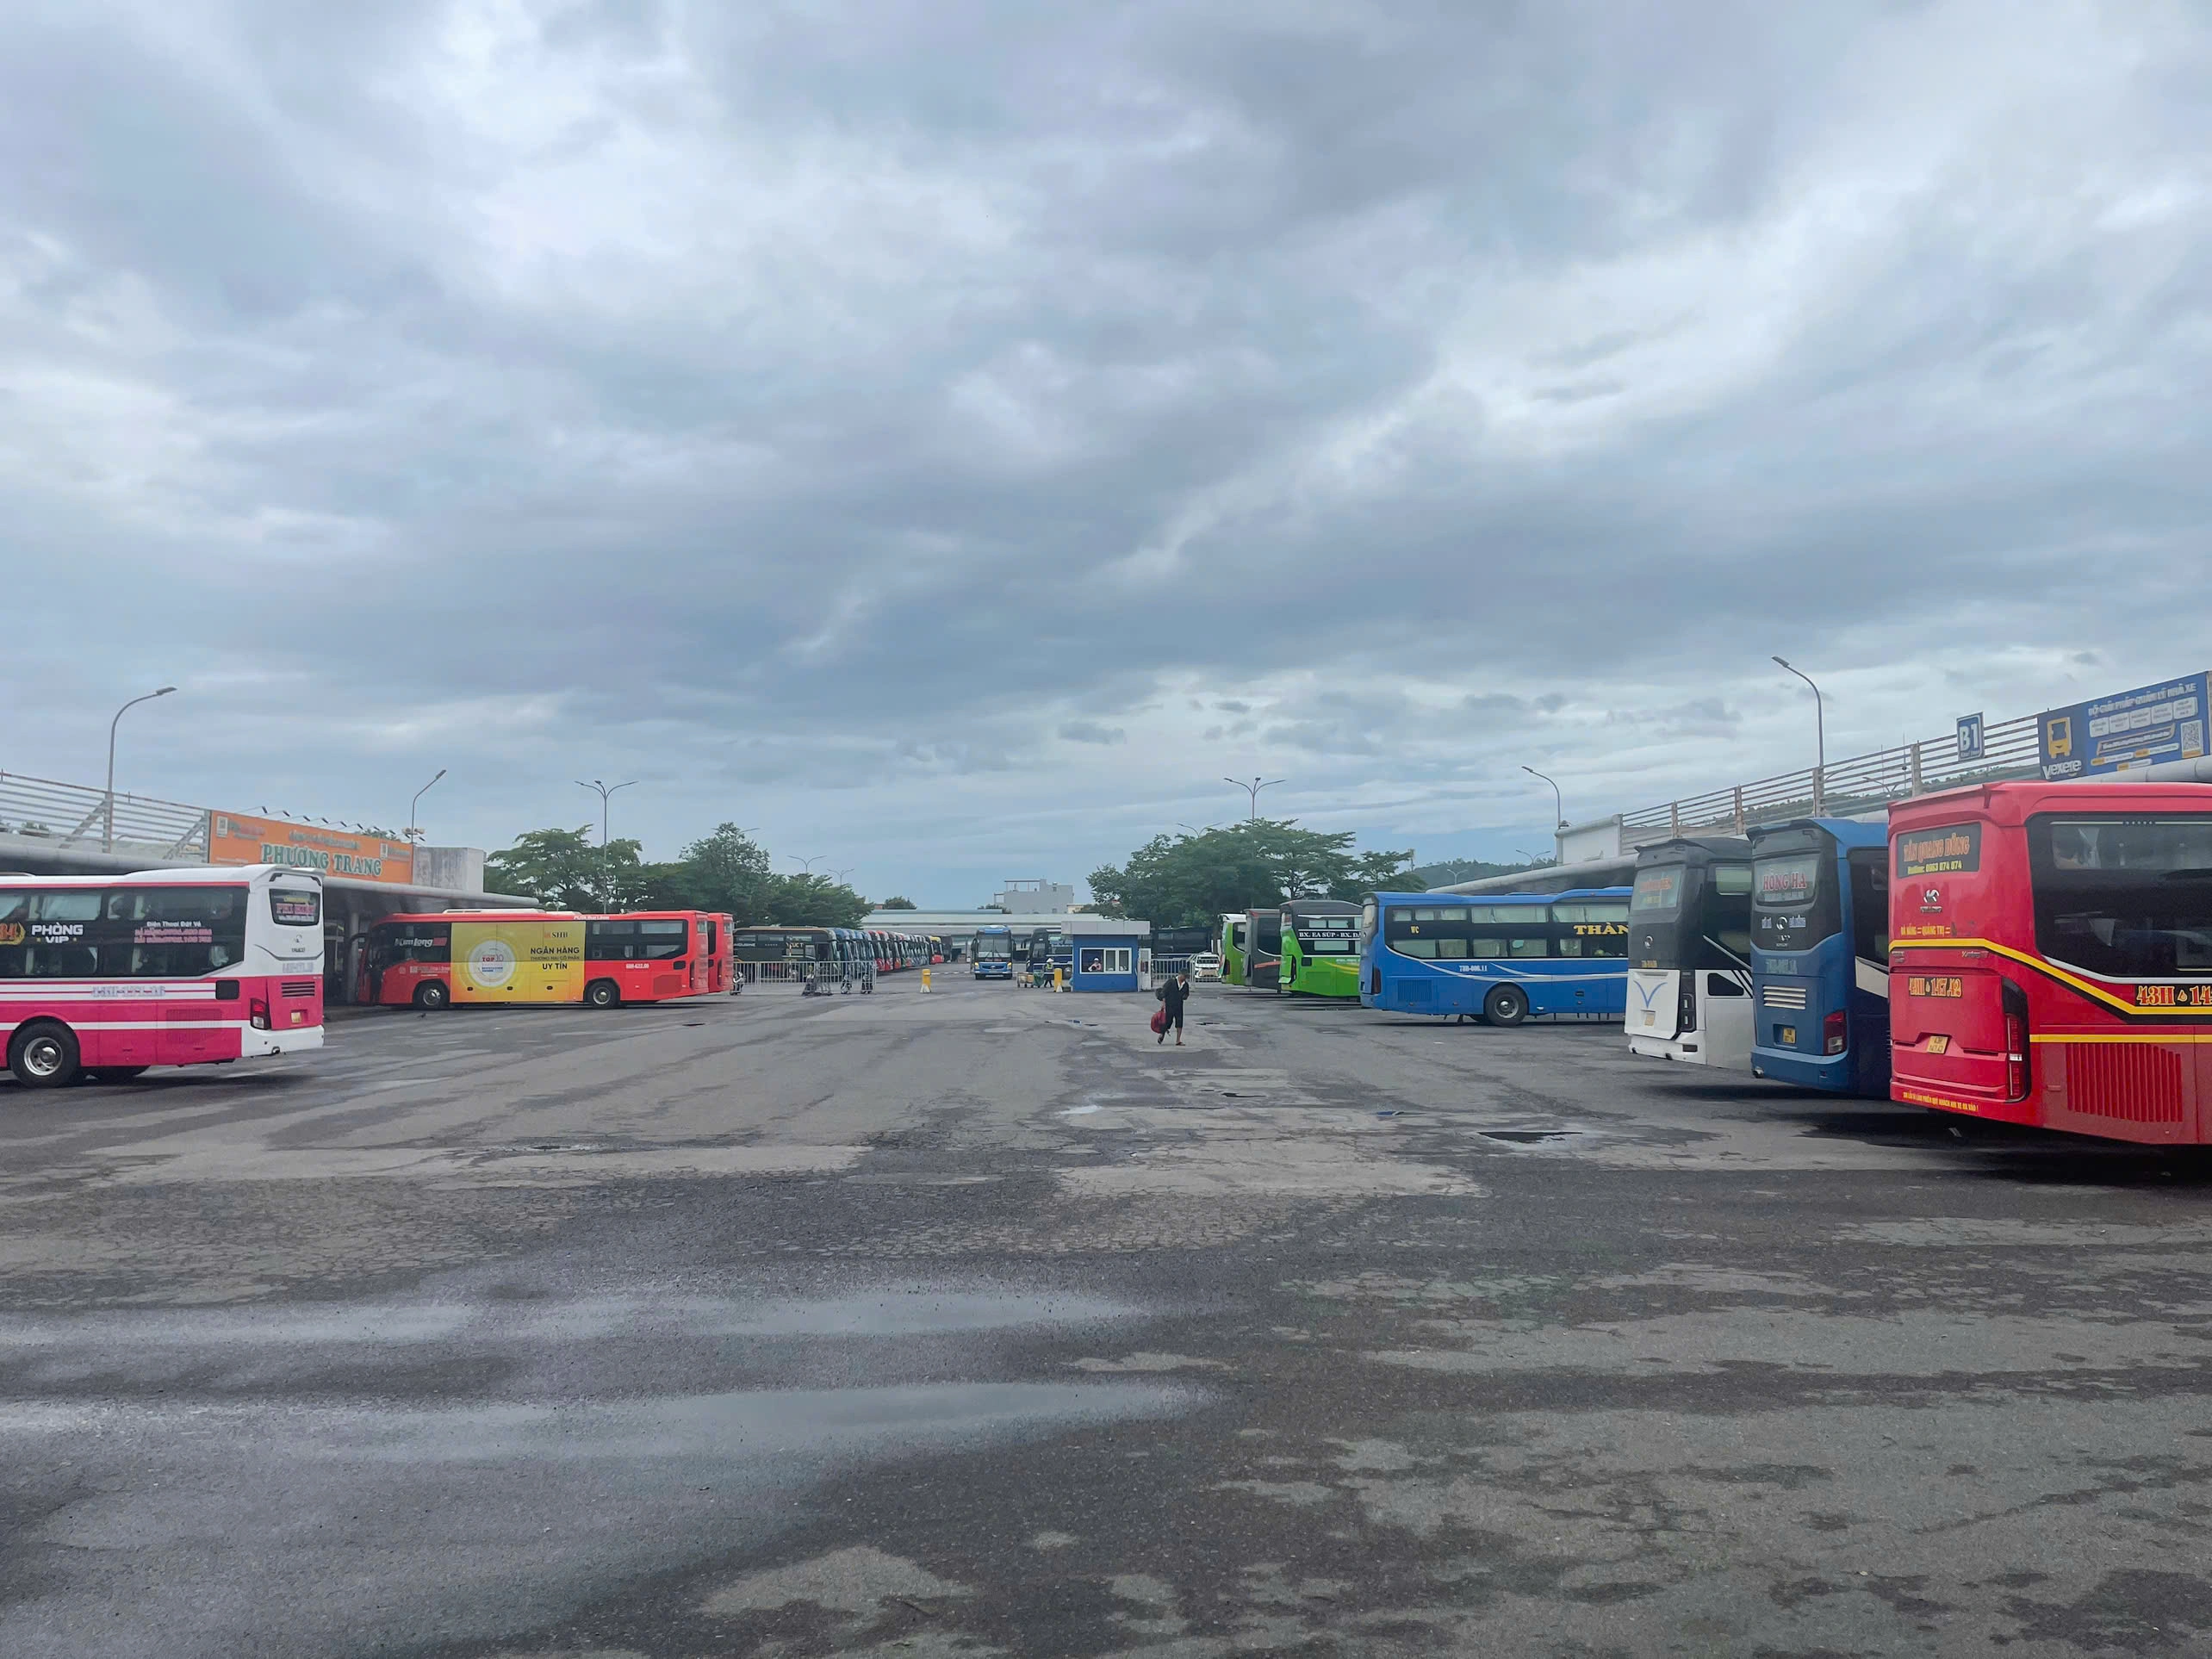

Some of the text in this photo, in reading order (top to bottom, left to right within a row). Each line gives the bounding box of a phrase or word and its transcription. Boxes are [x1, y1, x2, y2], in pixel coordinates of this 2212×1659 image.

[2184, 682, 2196, 694] XE
[1960, 724, 1979, 751] B1
[1917, 838, 1944, 864] QUANG
[261, 842, 383, 876] PHƯƠNG TRANG
[31, 922, 84, 935] PHÒNG
[1410, 925, 1420, 934] WC
[45, 935, 70, 944] VIP
[530, 946, 555, 954] NGÂN
[495, 954, 504, 962] 10
[555, 961, 568, 970] TÍN
[2136, 985, 2212, 1006] 43H 14
